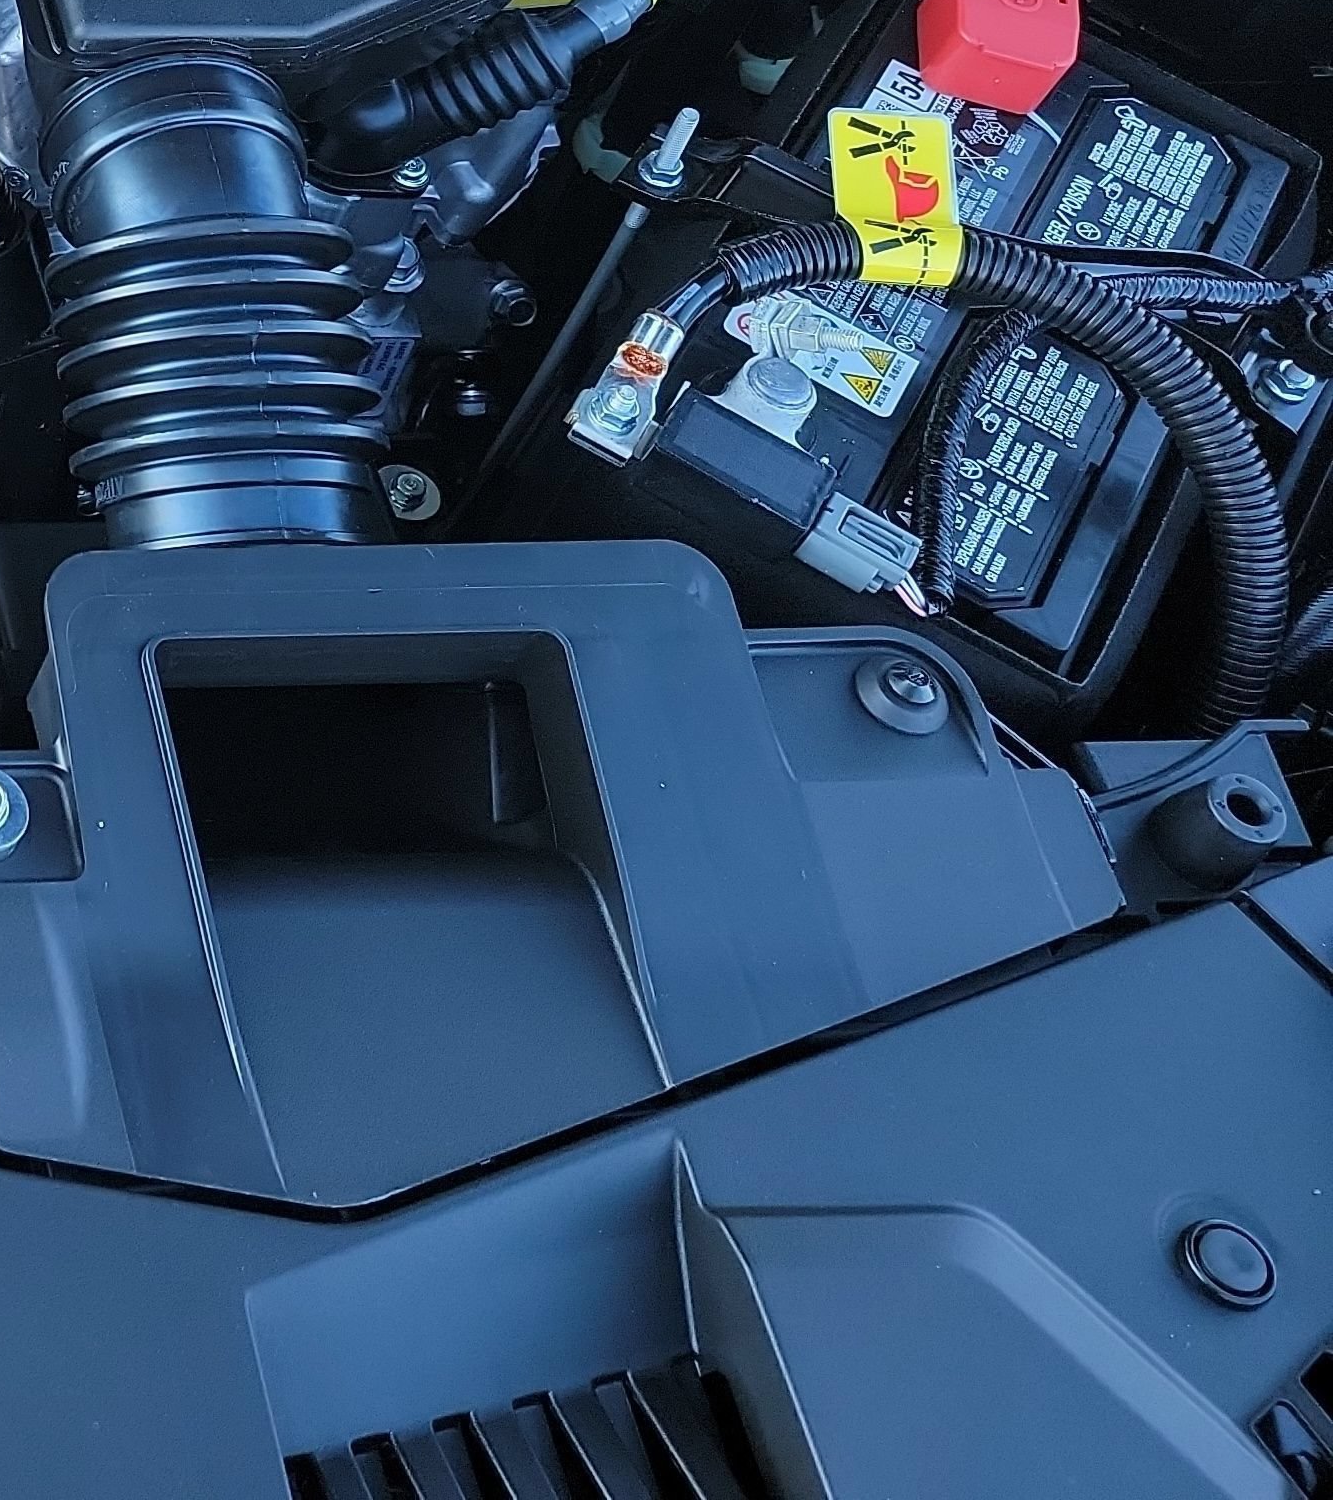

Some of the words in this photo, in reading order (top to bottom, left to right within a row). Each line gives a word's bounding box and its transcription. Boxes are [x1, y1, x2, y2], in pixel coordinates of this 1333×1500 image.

[992, 163, 1010, 181] Pb
[1043, 345, 1061, 365] FAST
[990, 358, 1021, 401] IMMEDIATELY
[1035, 360, 1053, 379] HELP
[1003, 387, 1023, 408] WITH
[1036, 393, 1052, 408] OUT
[1042, 385, 1055, 397] OF
[1030, 403, 1047, 421] KEEP
[1041, 415, 1054, 427] OF
[1062, 420, 1079, 438] CAPS
[1075, 395, 1091, 411] AND
[985, 431, 1014, 468] SULFURIC
[1001, 414, 1022, 436] ACID
[1009, 441, 1028, 462] CAUSE
[1015, 448, 1041, 483] BLINDNESS
[1030, 440, 1045, 453] OR
[1002, 457, 1020, 476] CAN
[1029, 465, 1050, 490] SEVERE
[968, 479, 987, 497] NO
[952, 527, 983, 567] EXPLOSIVE
[969, 506, 993, 533] GASES
[974, 543, 994, 565] CAUSE
[969, 560, 986, 576] CAN
